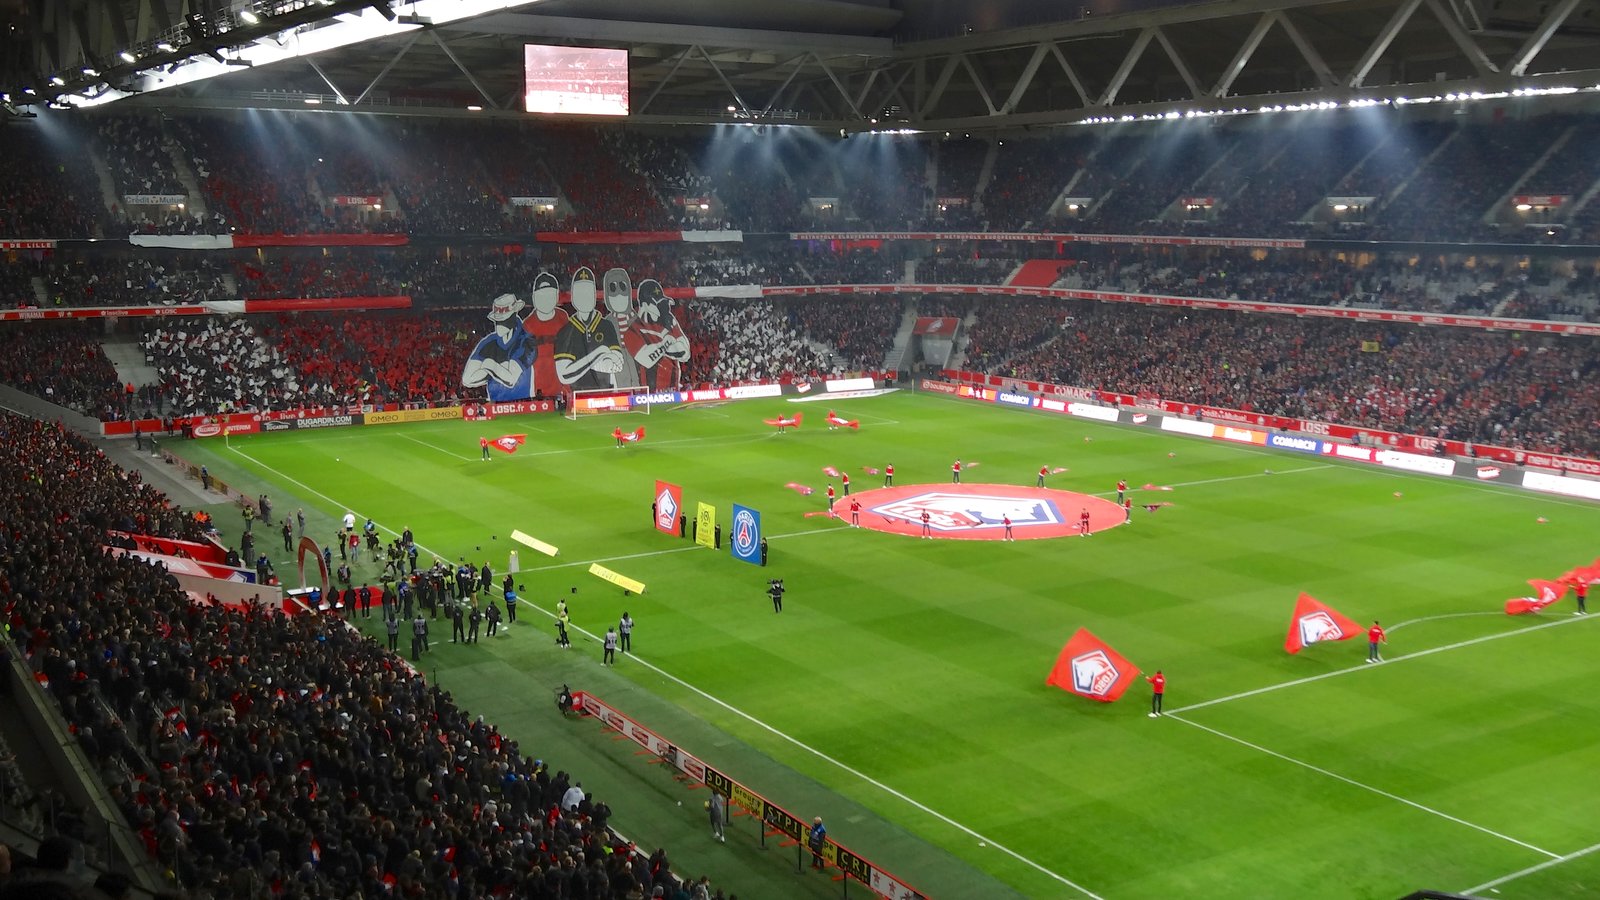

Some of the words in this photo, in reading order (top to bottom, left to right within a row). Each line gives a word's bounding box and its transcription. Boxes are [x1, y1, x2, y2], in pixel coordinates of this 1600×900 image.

[635, 392, 674, 404] COMARCH
[1054, 386, 1093, 400] COMARC
[492, 404, 525, 415] LOSC.fr
[297, 415, 352, 426] DUGARDIN.COM
[1300, 421, 1330, 435] LOSC
[1527, 455, 1551, 466] new
[1551, 456, 1600, 473] balance
[707, 770, 729, 792] SDI
[767, 806, 799, 834] STPI
[841, 851, 868, 876] CRI
